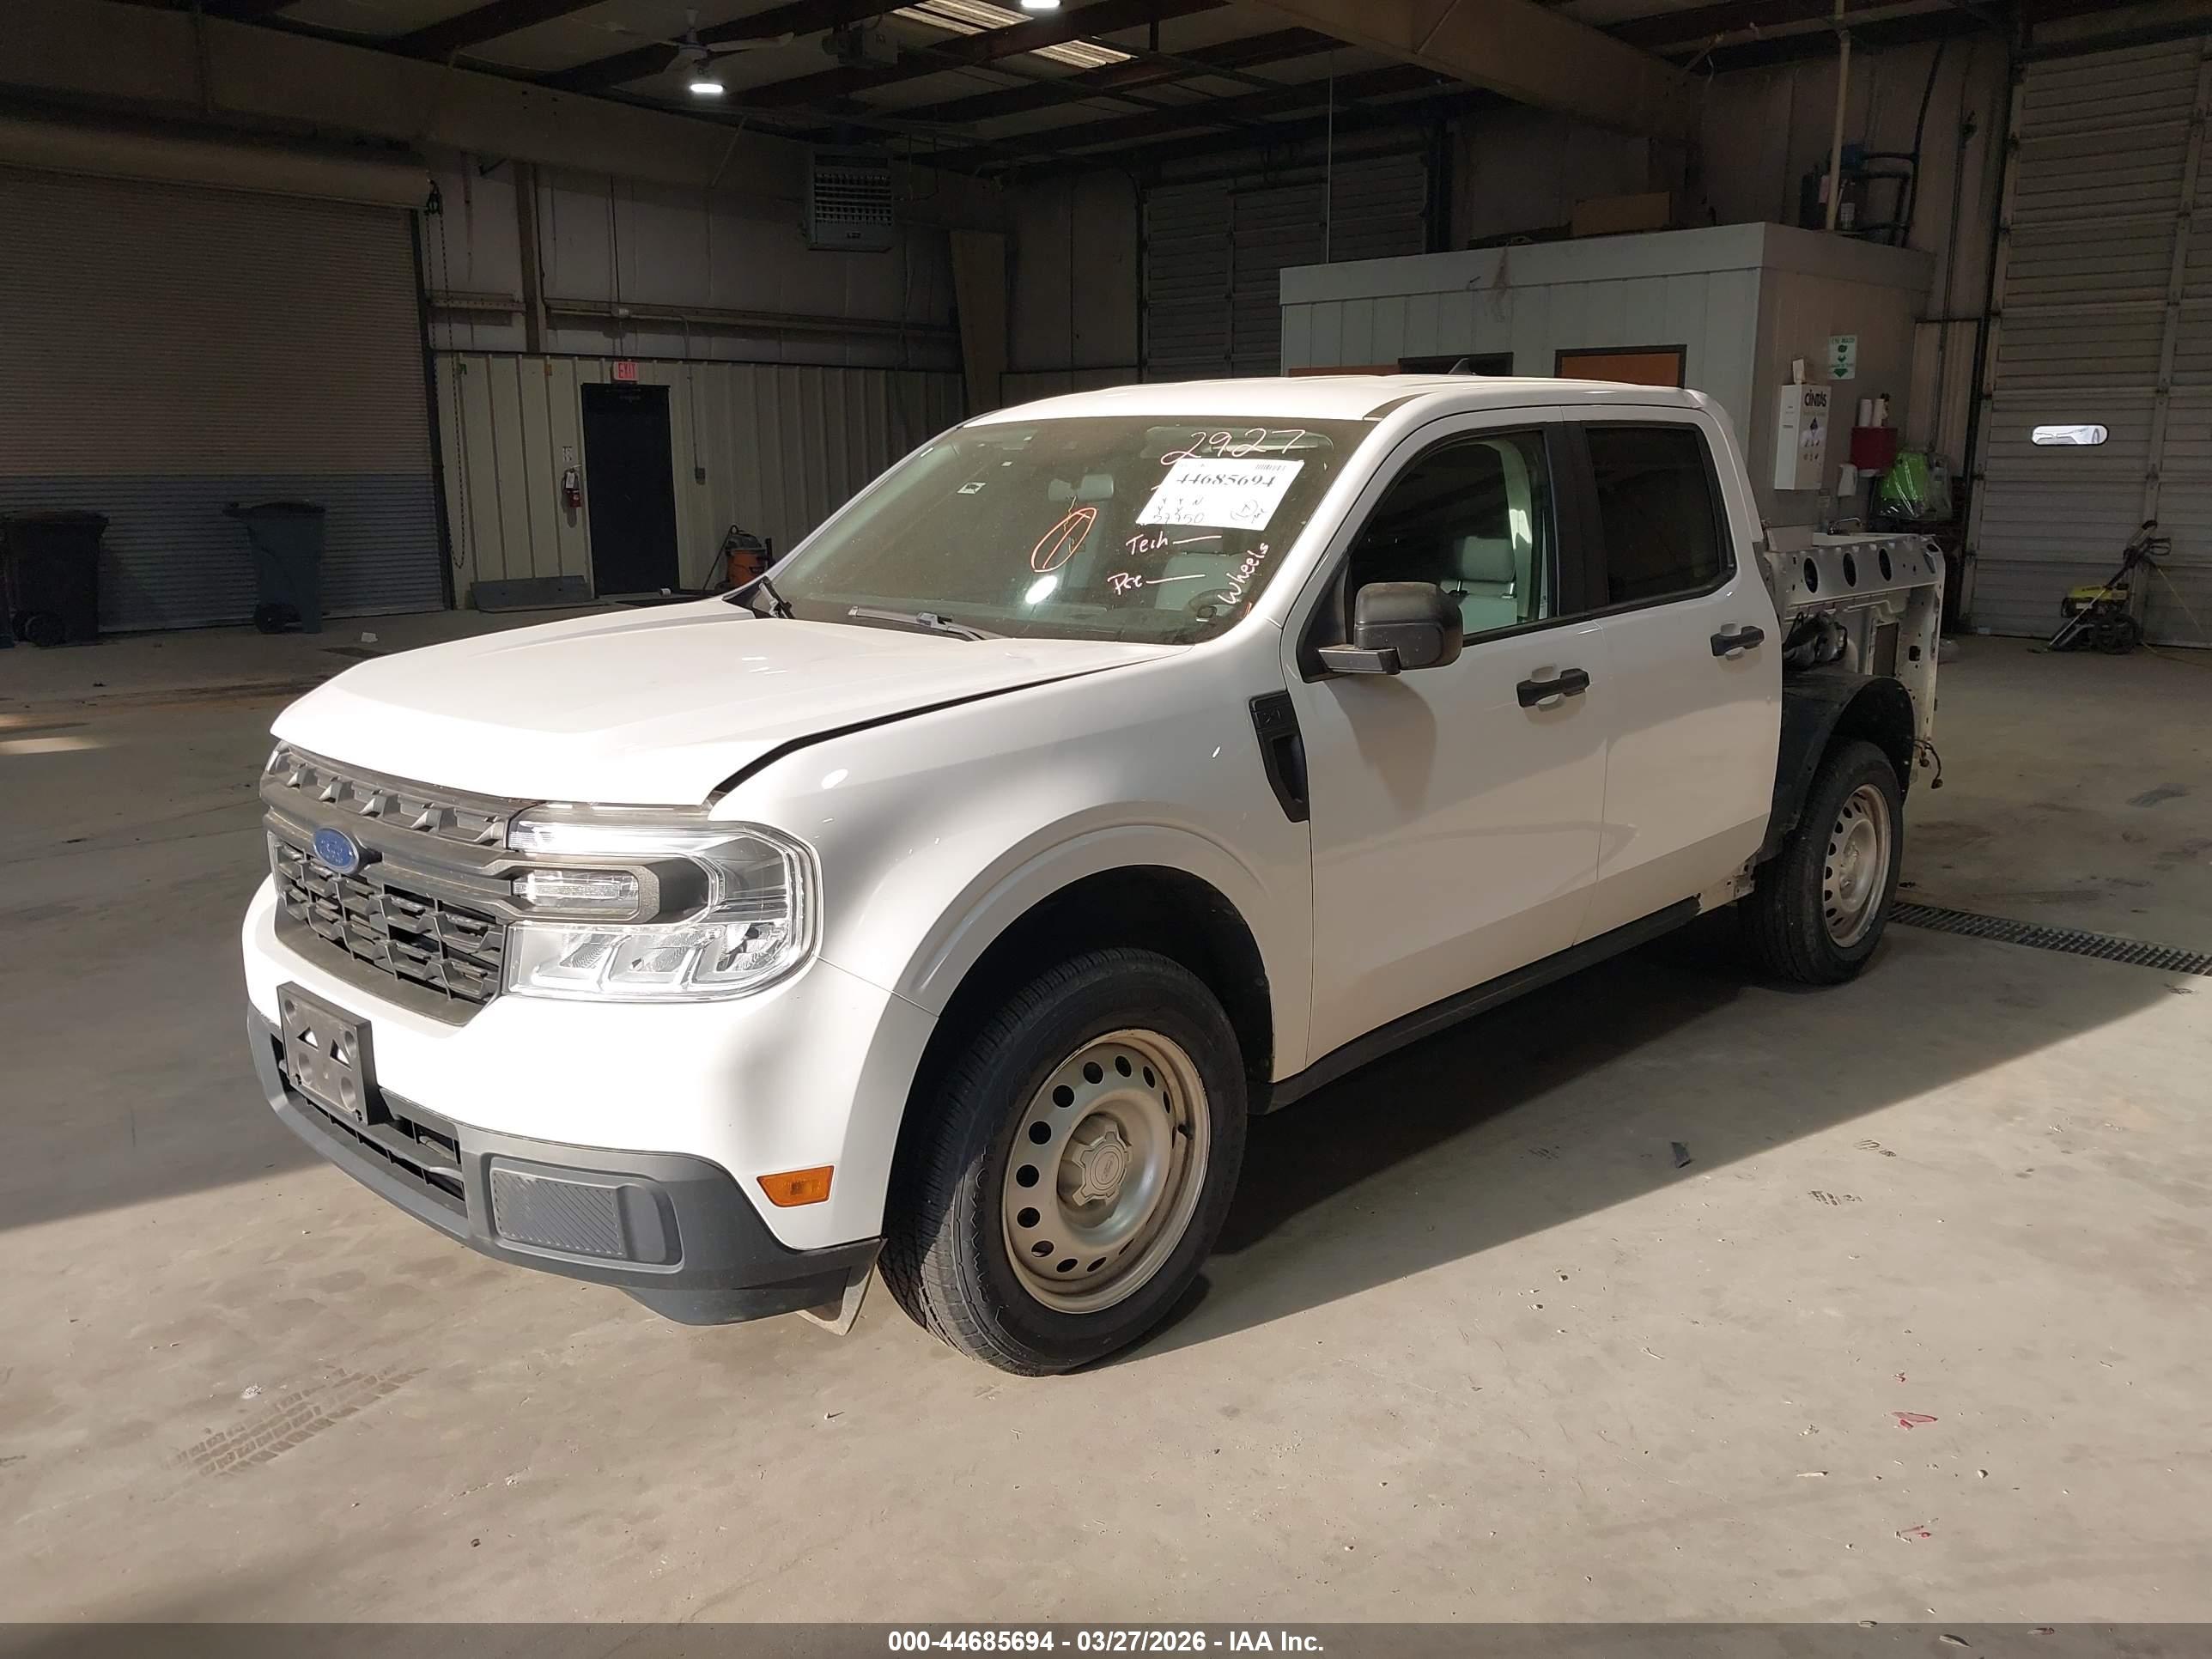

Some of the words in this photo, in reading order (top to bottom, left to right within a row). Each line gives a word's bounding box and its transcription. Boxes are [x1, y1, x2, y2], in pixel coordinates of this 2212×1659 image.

[618, 362, 635, 378] EXIT
[1160, 428, 1306, 465] 2927
[1176, 473, 1276, 488] 44685694
[1218, 543, 1269, 605] Wheels
